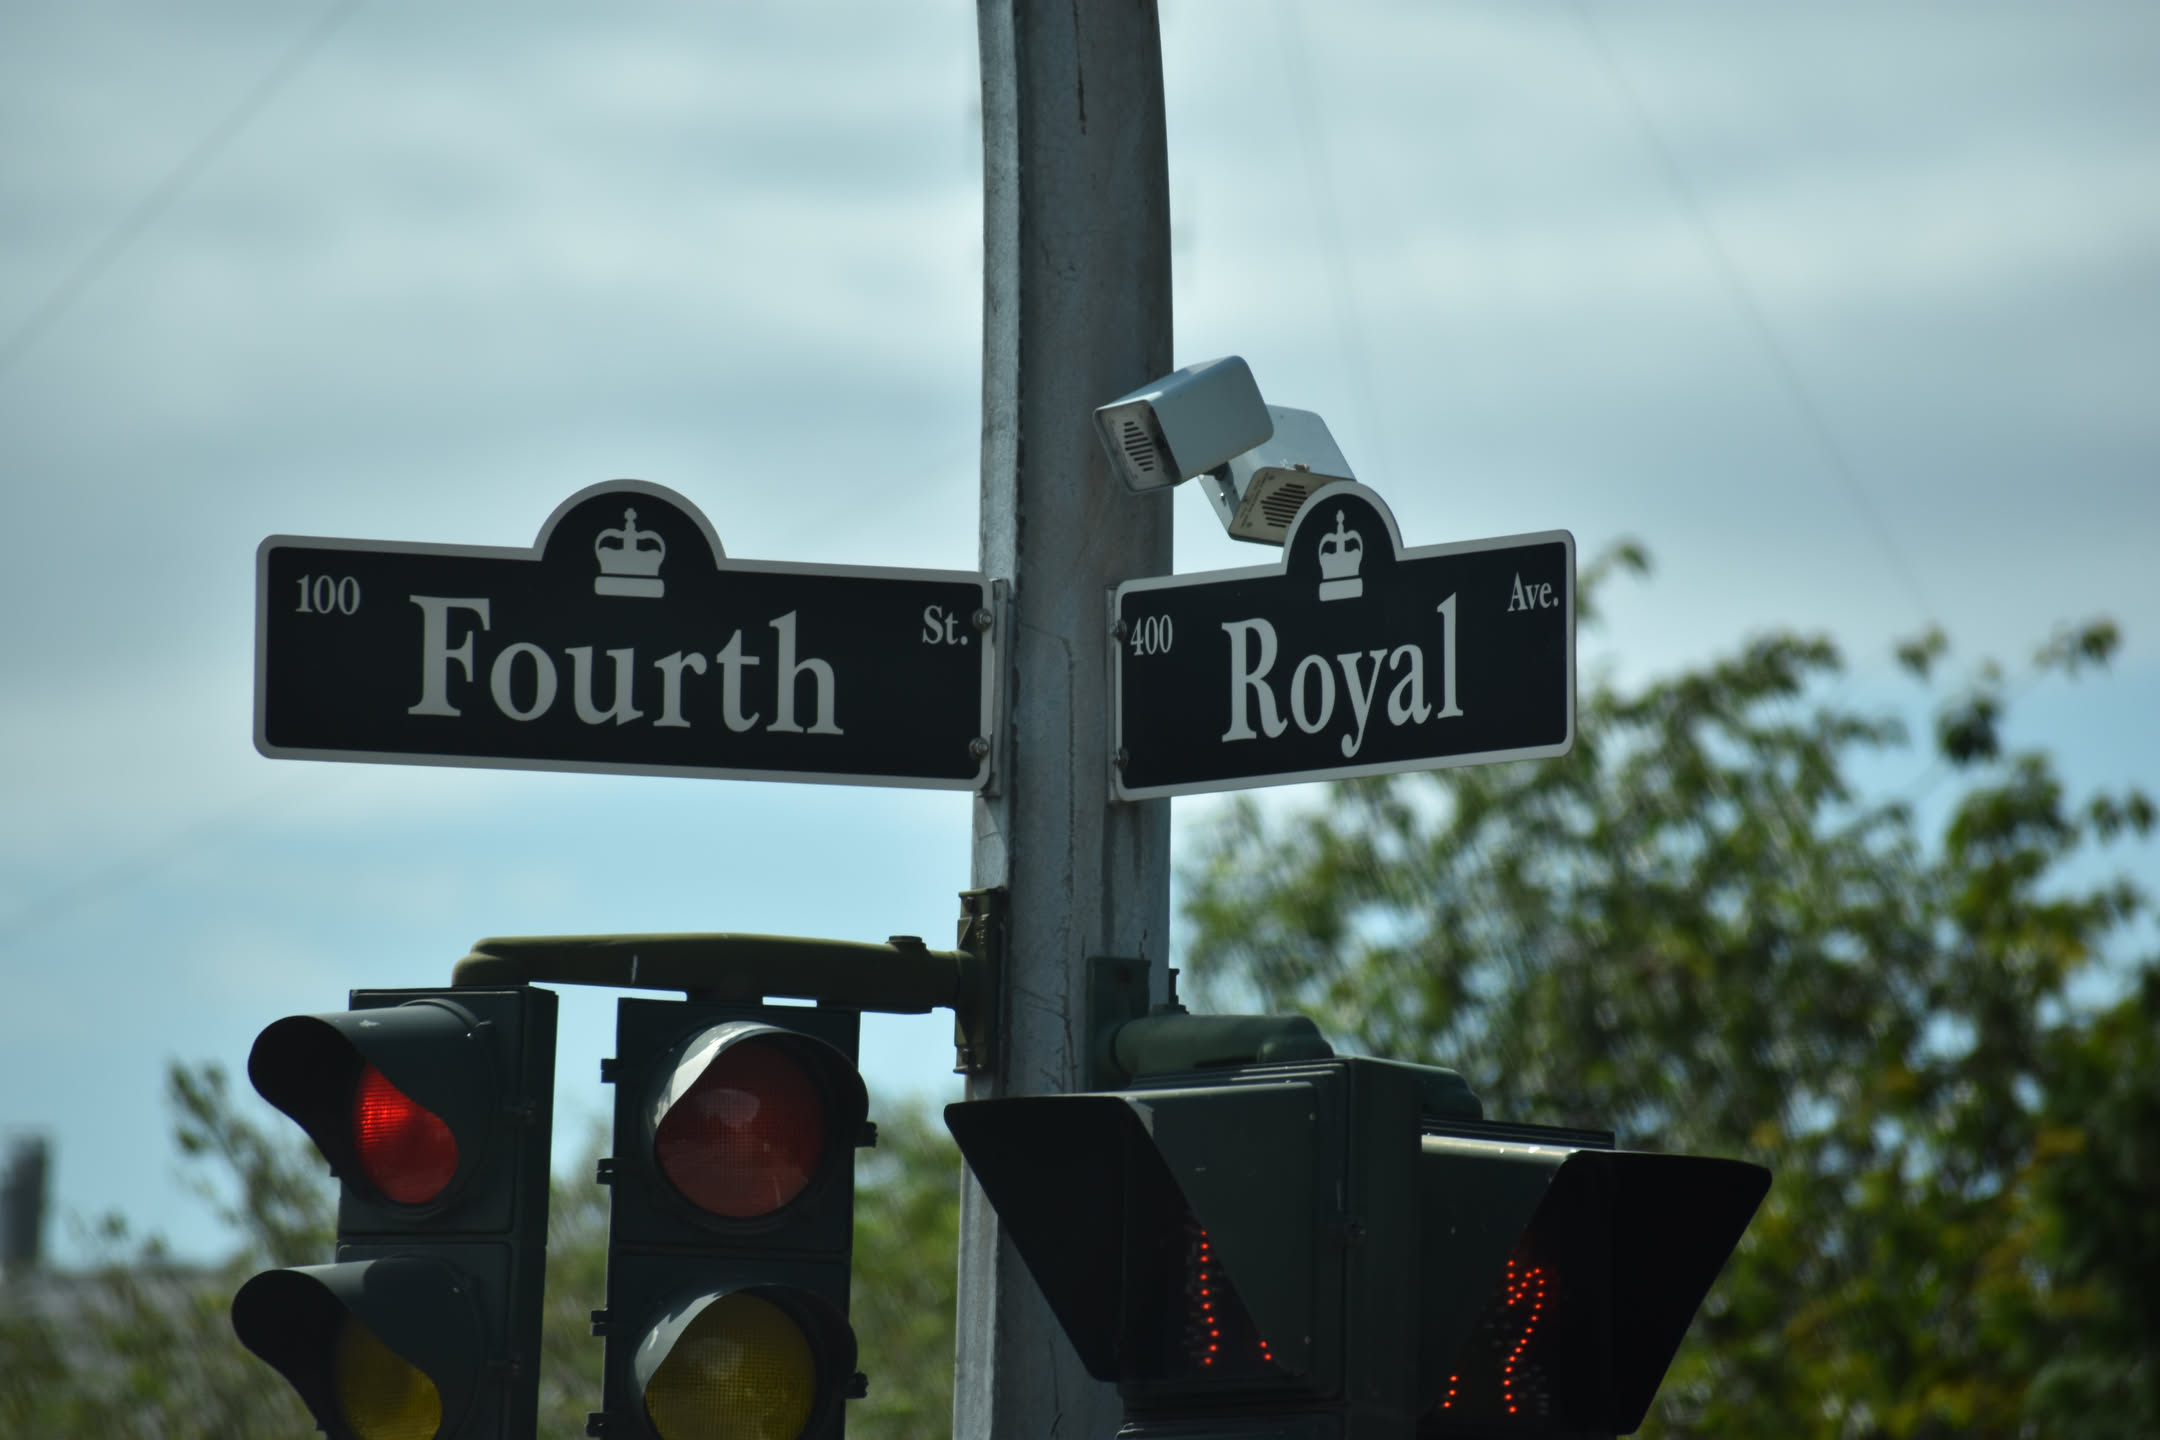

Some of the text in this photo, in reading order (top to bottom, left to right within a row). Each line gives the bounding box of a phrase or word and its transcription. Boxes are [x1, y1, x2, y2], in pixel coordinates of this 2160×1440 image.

[295, 574, 969, 735] 100 Fourth St.
[1130, 572, 1559, 758] 400 Royal Ave.
